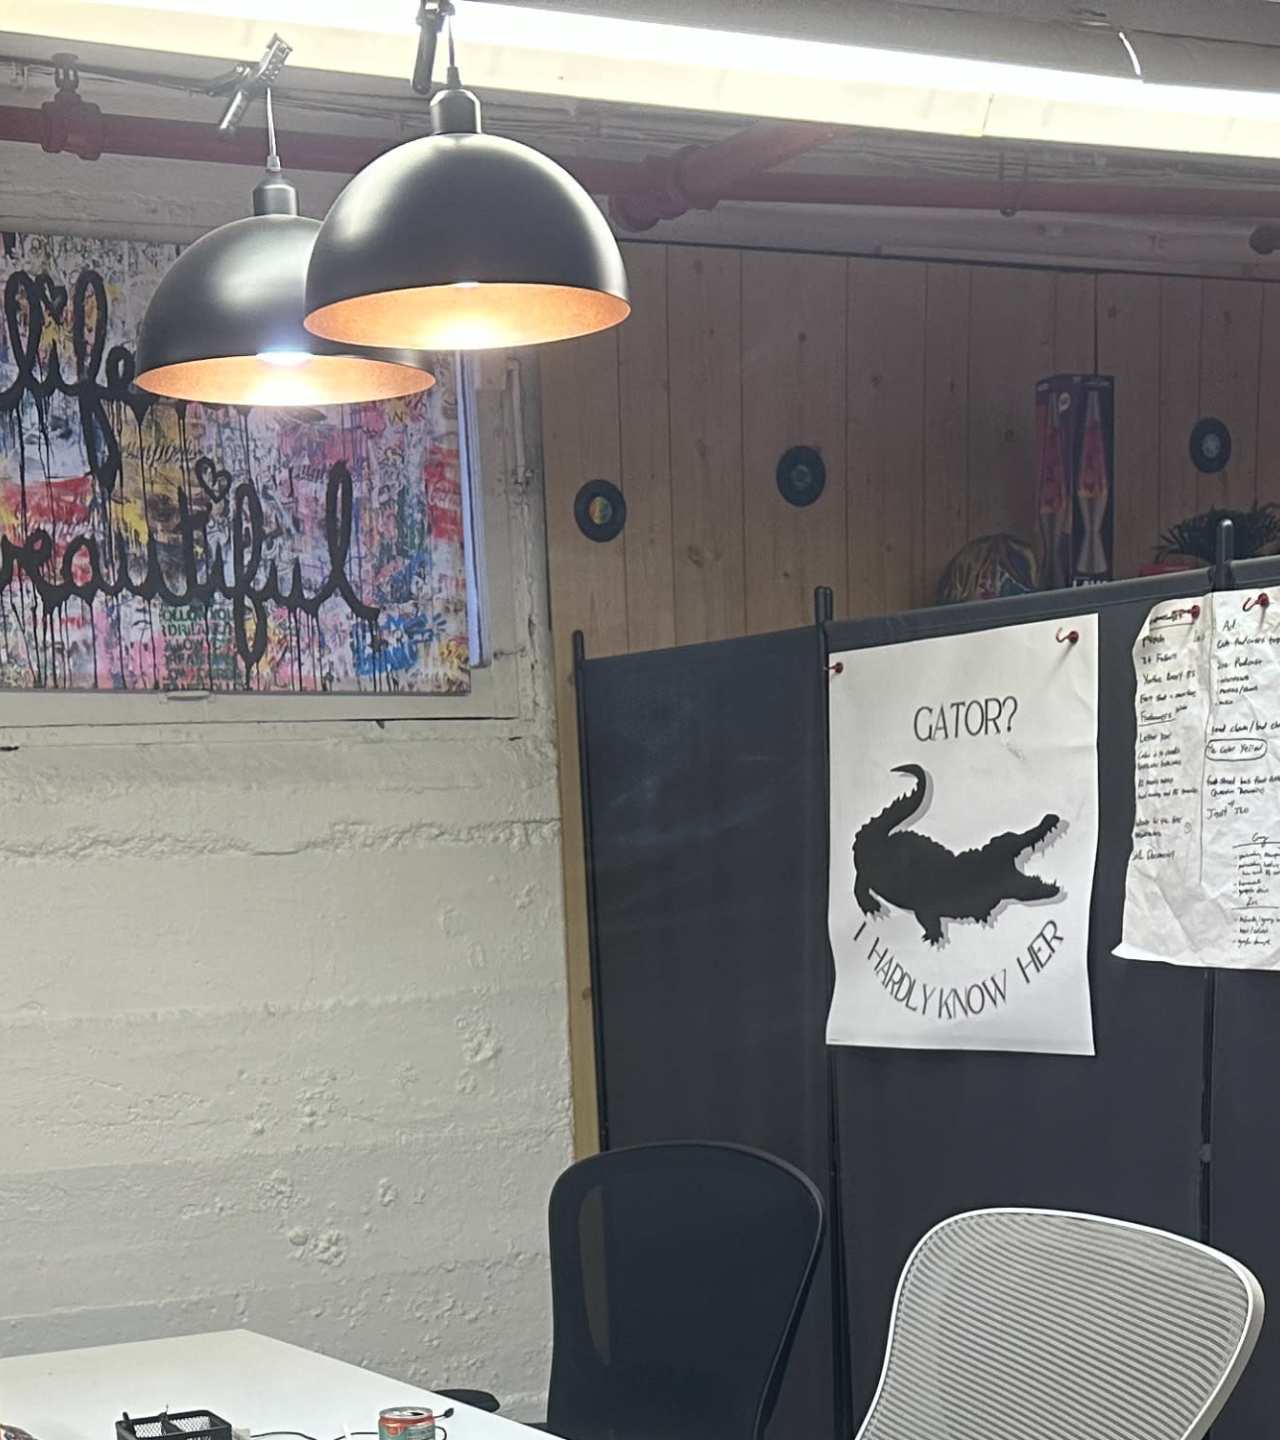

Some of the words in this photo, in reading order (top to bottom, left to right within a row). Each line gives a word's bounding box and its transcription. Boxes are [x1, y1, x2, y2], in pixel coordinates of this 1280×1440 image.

[913, 695, 1018, 742] GATOR?
[852, 920, 867, 942] I
[867, 936, 929, 1016] HARDLY
[937, 968, 1008, 1020] KNOW
[1015, 918, 1065, 985] HER
